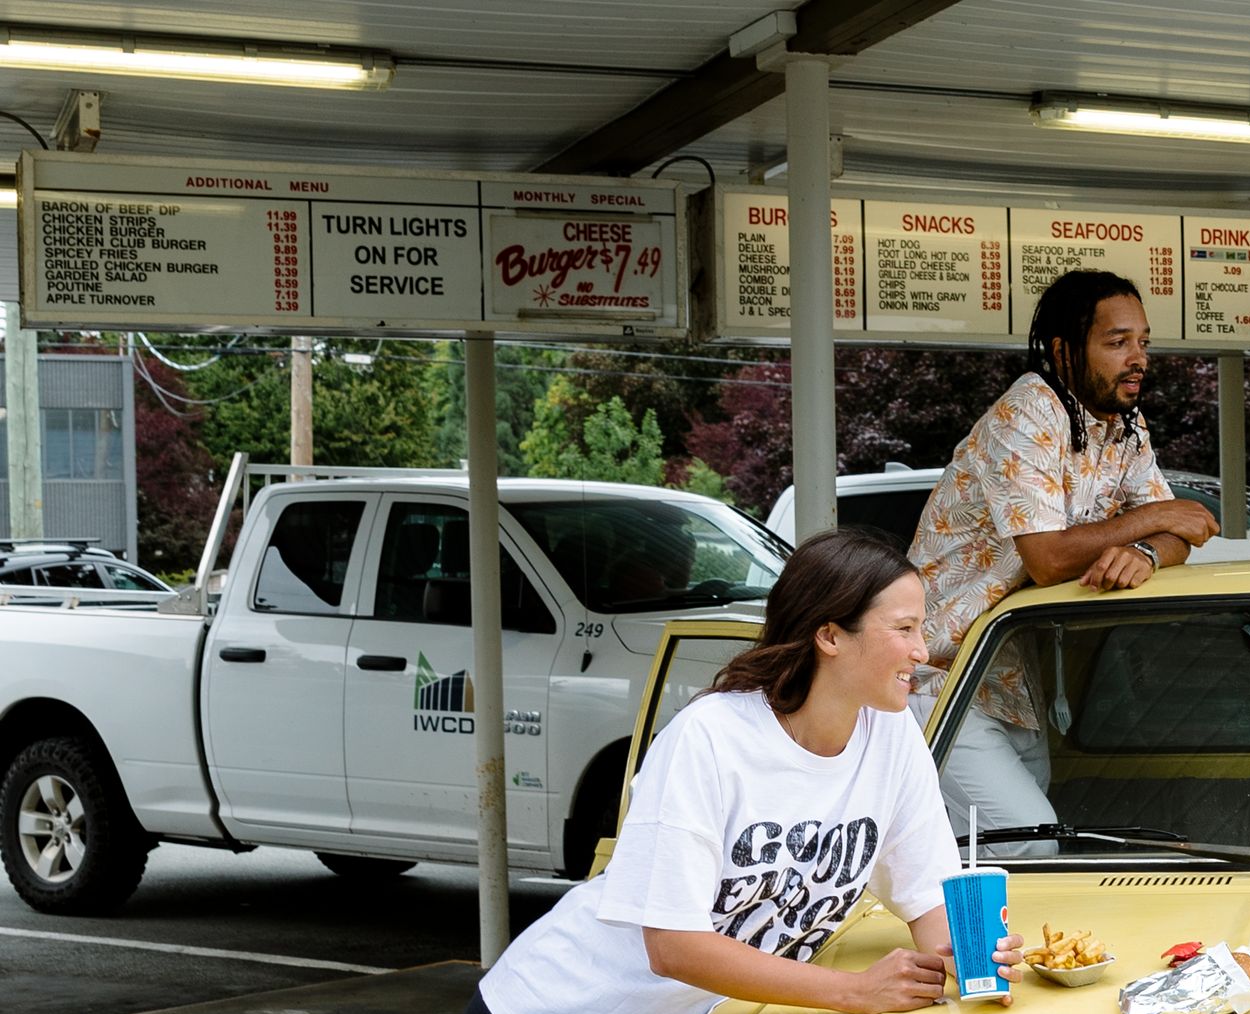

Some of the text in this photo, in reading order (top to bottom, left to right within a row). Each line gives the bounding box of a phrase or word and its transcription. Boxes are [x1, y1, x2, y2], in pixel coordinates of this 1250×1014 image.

[185, 177, 329, 192] ADDITIONAL MENU
[513, 191, 645, 207] MONTHLY SPECIAL
[42, 201, 181, 216] BARON OF BEEF DIP
[42, 213, 156, 227] CHICKEN STRIPS
[267, 211, 297, 221] 11.99
[267, 222, 297, 232] 11.39
[322, 215, 467, 238] TURN LIGHTS
[902, 214, 975, 235] SNACKS
[42, 224, 165, 238] CHICKEN BURGER
[563, 222, 632, 243] CHEESE
[1051, 221, 1144, 242] SEAFOODS
[43, 235, 207, 251] CHICKEN CLUB BURGER
[273, 234, 297, 243] 9.19
[738, 232, 766, 243] PLAIN
[833, 234, 854, 244] 7.09
[273, 245, 298, 255] 9.89
[738, 243, 775, 254] DELUXE
[833, 245, 854, 254] 7.99
[878, 239, 920, 250] HOT DOG
[980, 241, 1000, 250] 6.39
[45, 247, 138, 260] SPICEY FRIES
[354, 245, 439, 266] ON FOR
[878, 249, 970, 262] FOOT LONG HOT DOG
[980, 251, 1000, 260] 8.59
[1022, 245, 1106, 257] SEAFOOD PLATTER
[1149, 247, 1173, 257] 11.89
[274, 256, 298, 266] 5.59
[738, 254, 776, 264] CHEESE
[833, 256, 854, 265] 8.19
[1022, 255, 1082, 267] FISH CHIPS
[1149, 257, 1173, 267] 11.89
[45, 259, 219, 274] GRILLED CHICKEN BURGER
[495, 241, 662, 293] Burger $7.49
[878, 259, 957, 271] GRILLED CHEESE
[981, 262, 1001, 271] 6.39
[1022, 265, 1059, 276] PRAWNS
[45, 270, 147, 283] GARDEN SALAD
[274, 268, 298, 278] 9.39
[834, 267, 854, 276] 8.19
[878, 269, 970, 282] GRILLED CHEESE BACON
[981, 272, 1001, 281] 6.89
[1149, 267, 1174, 276] 11.89
[1223, 266, 1242, 276] 3.09
[274, 279, 298, 289] 6.59
[350, 275, 444, 296] SERVICE
[739, 275, 775, 285] COMBO
[834, 277, 855, 287] 8.19
[878, 279, 906, 290] CHIPS
[1149, 277, 1174, 286] 11.89
[48, 282, 103, 293] POUTINE
[577, 281, 594, 293] NO
[739, 285, 777, 296] DOUBLE
[1195, 282, 1249, 293] HOT CHOCOLATE
[46, 293, 156, 306] APPLE TURNOVER
[275, 290, 298, 300] 7.19
[558, 293, 650, 308] SUBSTITUTES
[878, 290, 967, 302] CHIPS WITH GRAVY
[1195, 292, 1213, 301] MILK
[275, 301, 299, 311] 3.39
[739, 296, 772, 306] BACON
[834, 298, 855, 308] 8.19
[878, 300, 941, 312] ONION RINGS
[1196, 302, 1211, 311] TEA
[1195, 311, 1224, 321] COFFEE
[1196, 323, 1235, 334] ICE TEA
[575, 622, 604, 638] 249
[414, 714, 475, 735] IWCD
[731, 816, 879, 889] GOOD
